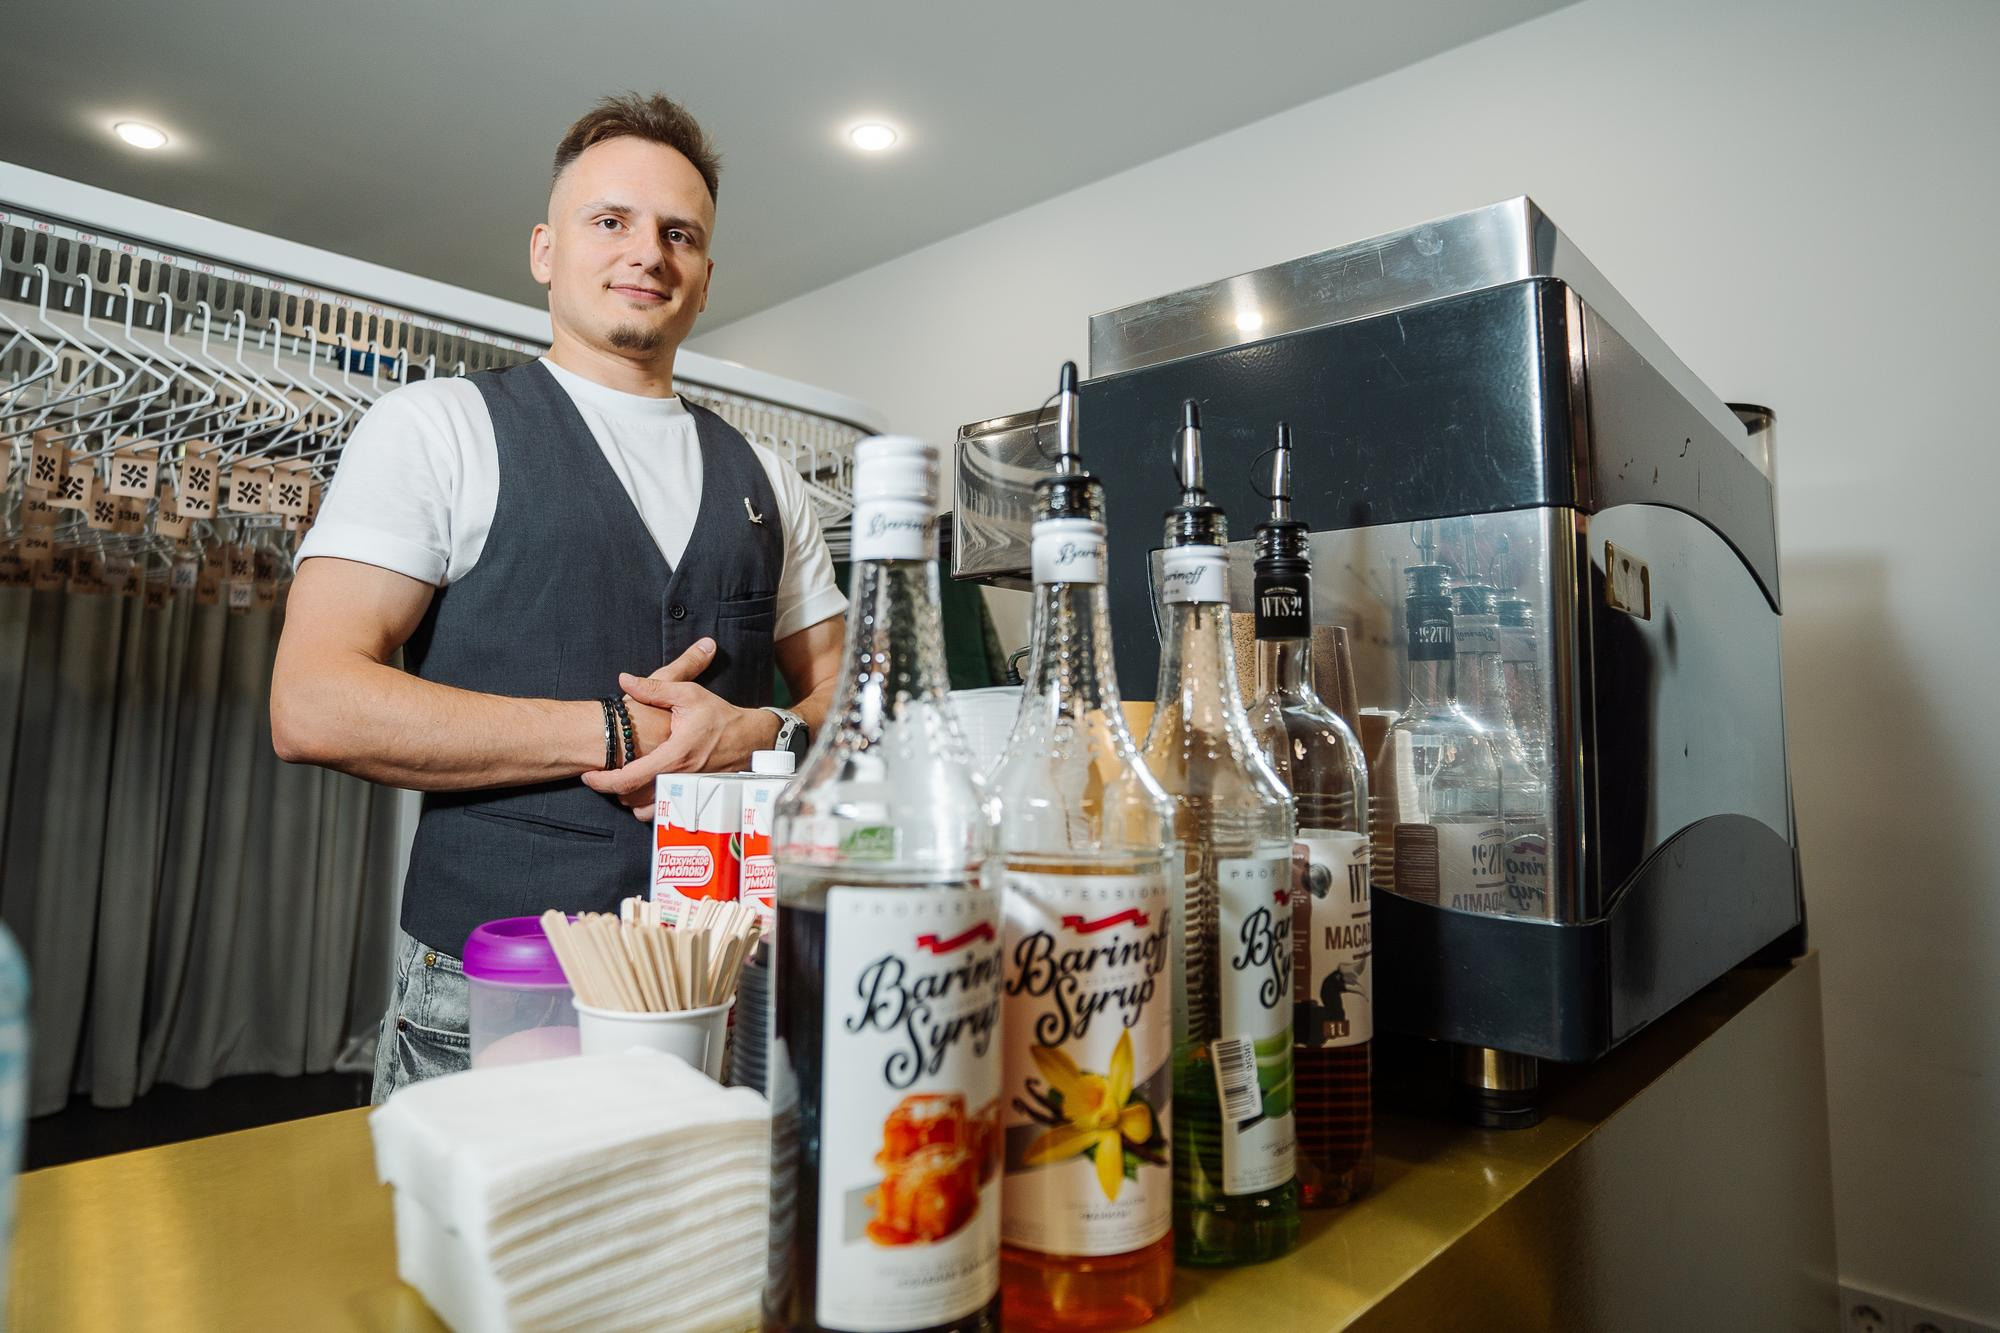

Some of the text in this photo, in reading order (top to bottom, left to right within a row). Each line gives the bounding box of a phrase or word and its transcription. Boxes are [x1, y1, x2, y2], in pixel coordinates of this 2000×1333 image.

[162, 511, 184, 525] 337
[1261, 596, 1303, 618] WTS?!
[659, 854, 709, 867] Шахунское
[745, 864, 776, 878] Шахун
[1035, 975, 1155, 1048] Syrup
